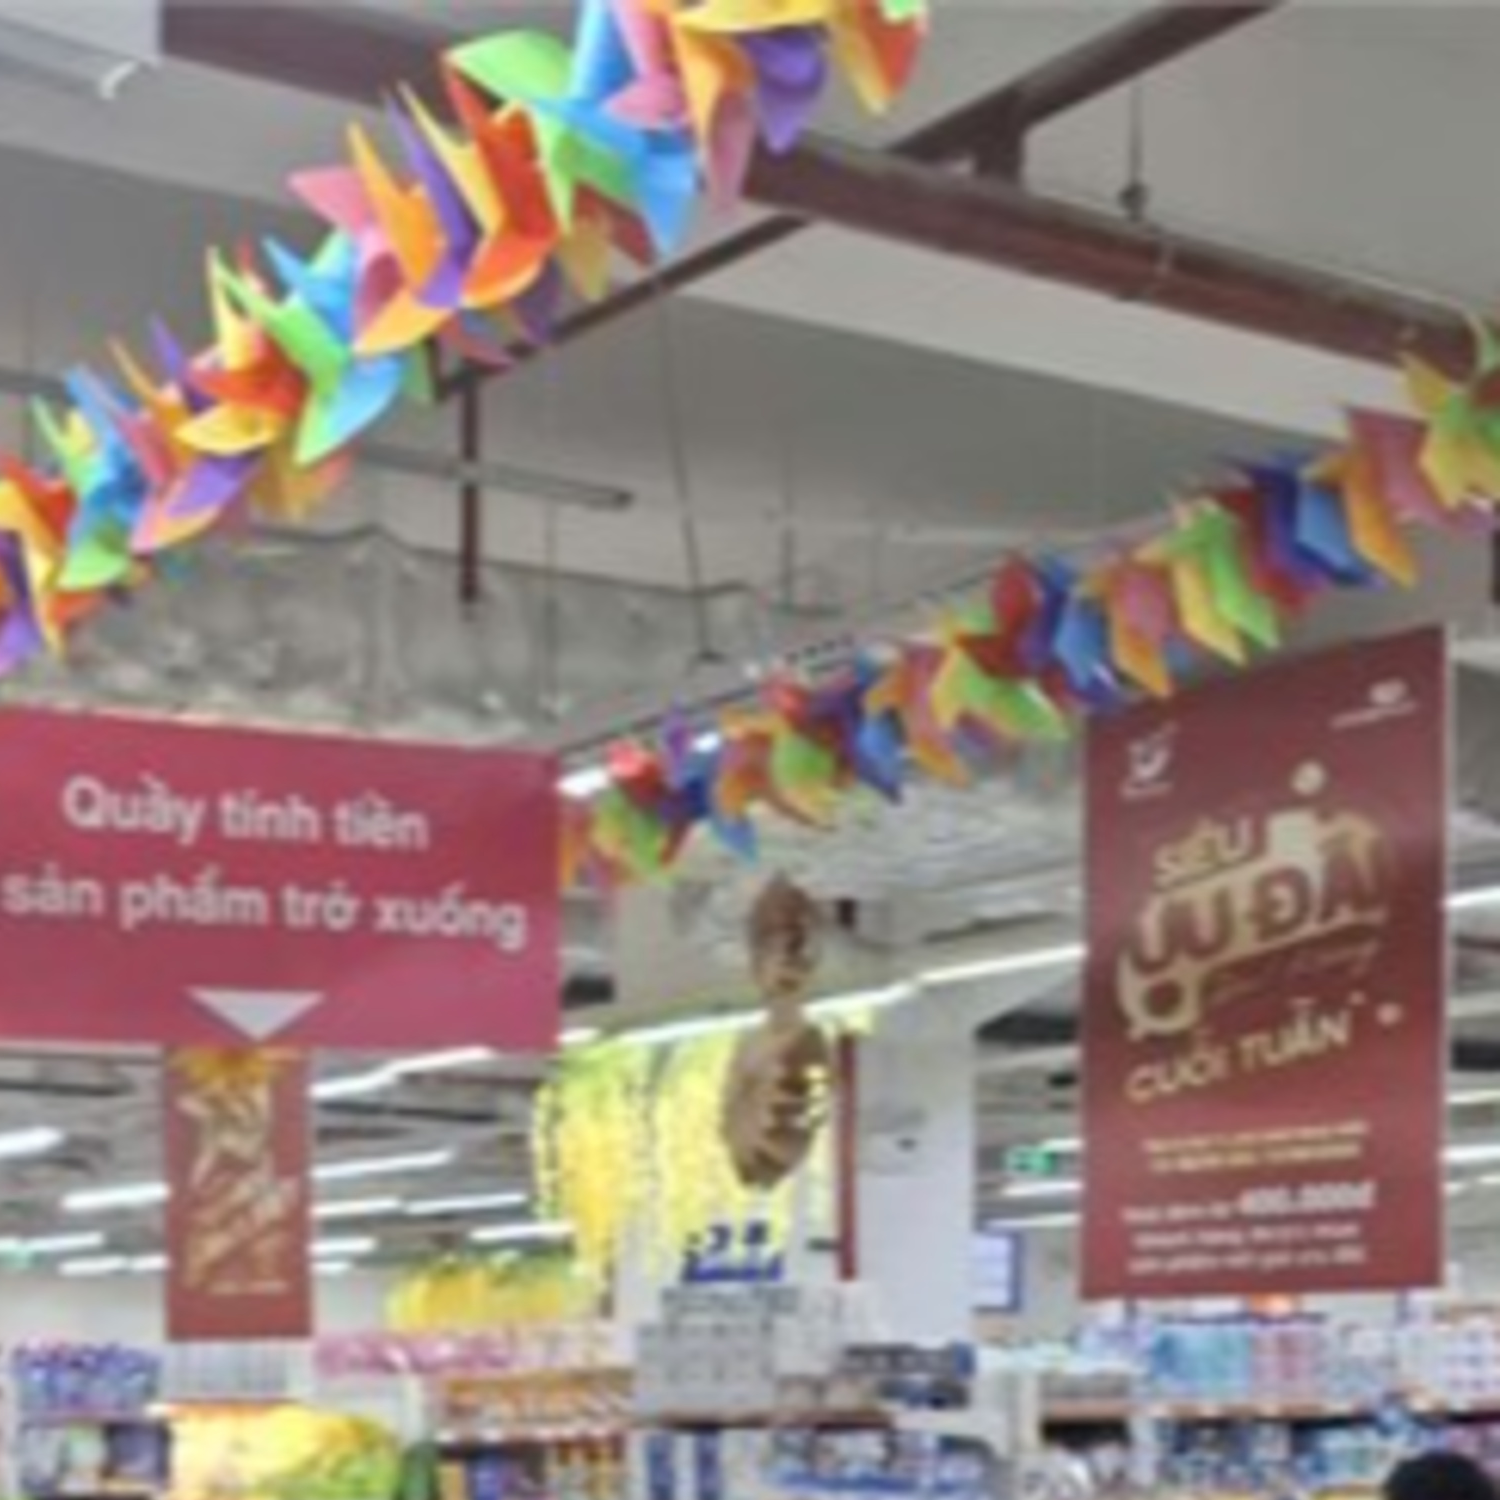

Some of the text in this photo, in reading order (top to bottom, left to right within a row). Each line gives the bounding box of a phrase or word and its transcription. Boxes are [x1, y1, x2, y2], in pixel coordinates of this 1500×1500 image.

[62, 774, 428, 850] Quầy tính tiền
[0, 865, 102, 916] sản
[119, 865, 270, 929] phẩm
[281, 886, 360, 932] trở
[372, 882, 527, 952] xuống
